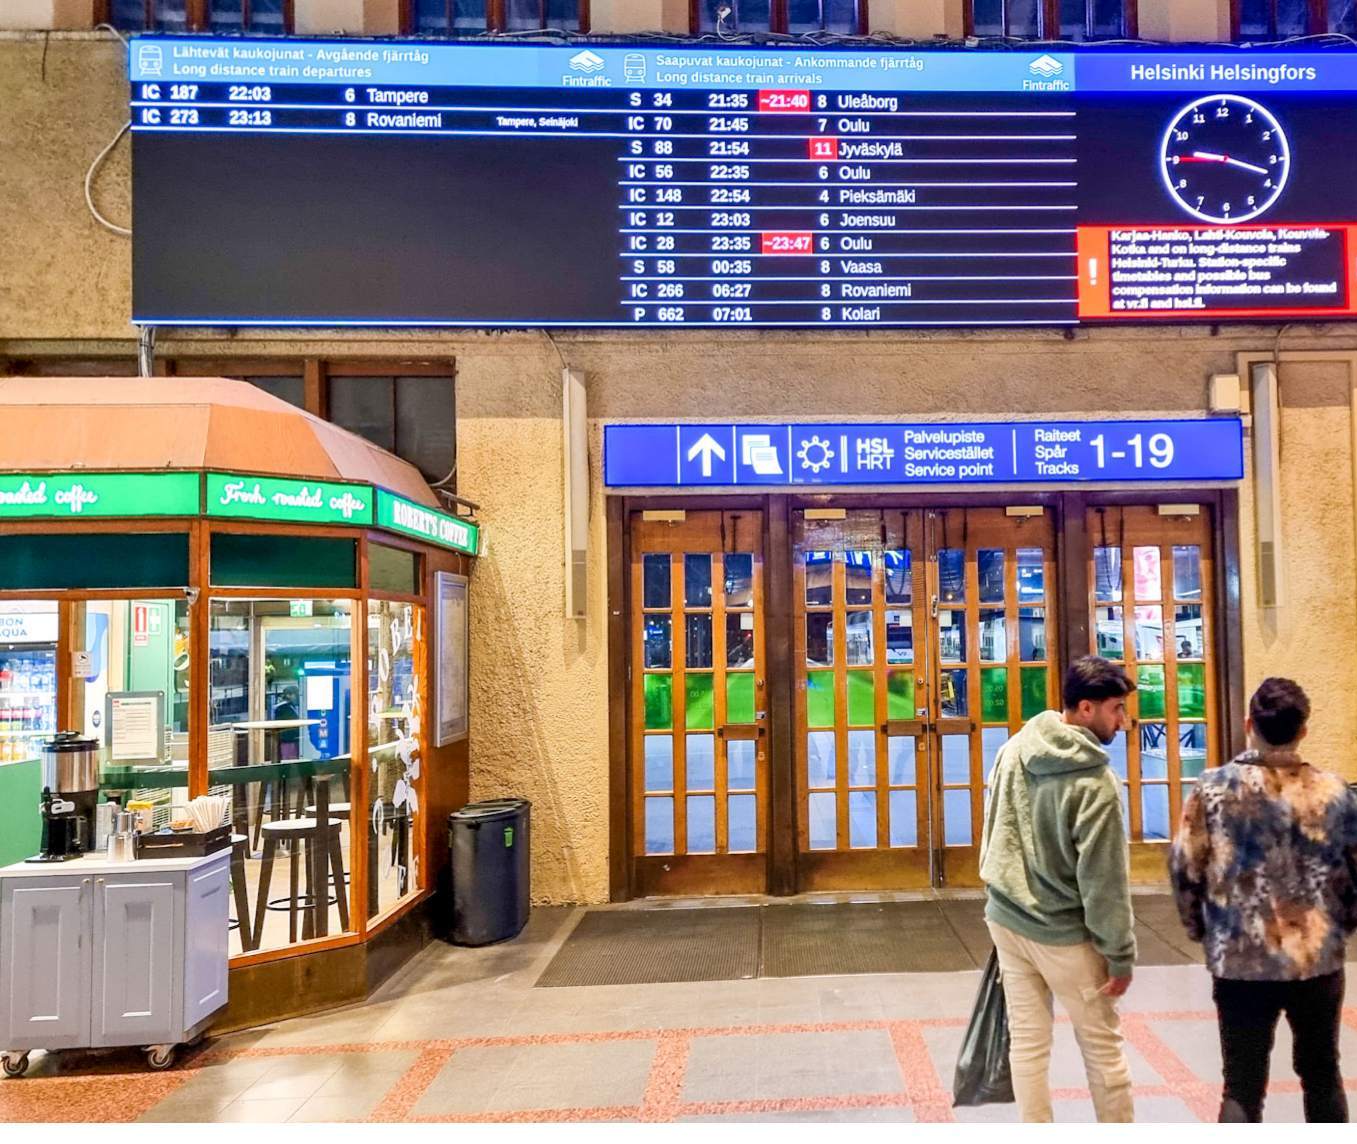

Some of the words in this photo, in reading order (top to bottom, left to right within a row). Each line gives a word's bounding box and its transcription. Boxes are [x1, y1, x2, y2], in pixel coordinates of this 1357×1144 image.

[173, 46, 229, 60] Lähtevät
[233, 46, 301, 62] kaukojunat
[316, 49, 379, 62] Avgående
[382, 49, 429, 65] fjärrtåg
[656, 55, 713, 70] Saapuvat
[717, 56, 783, 70] kaukojunat
[795, 57, 876, 69] Ankommande
[880, 57, 924, 71] fjärrtåg
[173, 63, 207, 77] Long
[211, 63, 265, 76] distance
[269, 64, 298, 77] train
[303, 65, 372, 79] departures
[657, 72, 693, 85] Long
[696, 72, 743, 84] distance
[746, 72, 775, 84] train
[778, 72, 822, 85] arrivals
[1131, 64, 1206, 80] Helsinki
[1210, 64, 1316, 84] Helsingfors
[563, 75, 612, 87] Fintraffic
[1023, 79, 1069, 92] Fintraffic
[143, 85, 160, 99] IC
[170, 85, 198, 100] 187
[230, 86, 271, 100] 22:03
[346, 88, 355, 102] 6
[367, 88, 429, 106] Tampere
[630, 93, 641, 106] S
[654, 93, 672, 106] 34
[708, 94, 747, 107] 21:35
[817, 95, 827, 108] 8
[838, 95, 898, 111] Uleåborg
[143, 109, 160, 123] IC
[170, 110, 199, 124] 273
[230, 111, 271, 125] 23:13
[346, 113, 356, 126] 8
[368, 112, 441, 128] Rovaniemi
[628, 117, 644, 130] IC
[654, 117, 672, 130] 70
[709, 118, 748, 131] 21:45
[818, 119, 827, 132] 7
[838, 119, 869, 132] Oulu
[631, 141, 642, 154] S
[655, 141, 673, 154] 88
[710, 142, 749, 155] 21:54
[815, 143, 831, 156] 11
[839, 143, 902, 158] Jyväskylä
[629, 165, 645, 178] IC
[655, 165, 673, 178] 56
[710, 166, 749, 179] 22:35
[819, 166, 828, 179] 6
[839, 166, 870, 179] Oulu
[630, 189, 646, 202] IC
[656, 189, 682, 202] 148
[711, 189, 750, 202] 22:54
[820, 190, 829, 203] 4
[840, 190, 916, 203] Pieksämäki
[630, 213, 646, 226] IC
[656, 213, 674, 226] 12
[711, 213, 750, 226] 23:03
[820, 214, 829, 226] 6
[840, 213, 895, 227] Joensuu
[631, 236, 647, 250] IC
[657, 237, 674, 250] 28
[712, 237, 751, 250] 23:35
[820, 237, 829, 250] 6
[841, 237, 872, 250] Oulu
[634, 260, 644, 273] S
[657, 261, 675, 273] 58
[712, 261, 751, 273] 00:35
[821, 261, 830, 273] 8
[841, 260, 882, 273] Vaasa
[632, 284, 648, 297] IC
[658, 284, 683, 297] 266
[713, 284, 752, 297] 06:27
[821, 285, 830, 297] 8
[841, 283, 911, 297] Rovaniemi
[635, 308, 645, 321] P
[658, 308, 684, 321] 662
[713, 308, 752, 320] 07:01
[822, 308, 831, 320] 8
[842, 307, 880, 320] Kolari
[857, 438, 894, 453] HSL
[904, 430, 984, 446] Palvelupiste
[1035, 429, 1081, 441] Raiteet
[1090, 433, 1174, 468] 1-19
[857, 454, 894, 470] HRT
[905, 446, 994, 460] Servicestället
[1035, 445, 1067, 461] Spår
[905, 463, 955, 476] Service
[959, 463, 993, 479] point
[1035, 462, 1079, 474] Tracks
[55, 484, 98, 512] coffee
[220, 481, 266, 504] Fresh
[271, 487, 323, 507] roasted
[329, 492, 365, 518] coffee
[393, 500, 437, 536] ROBERT'S
